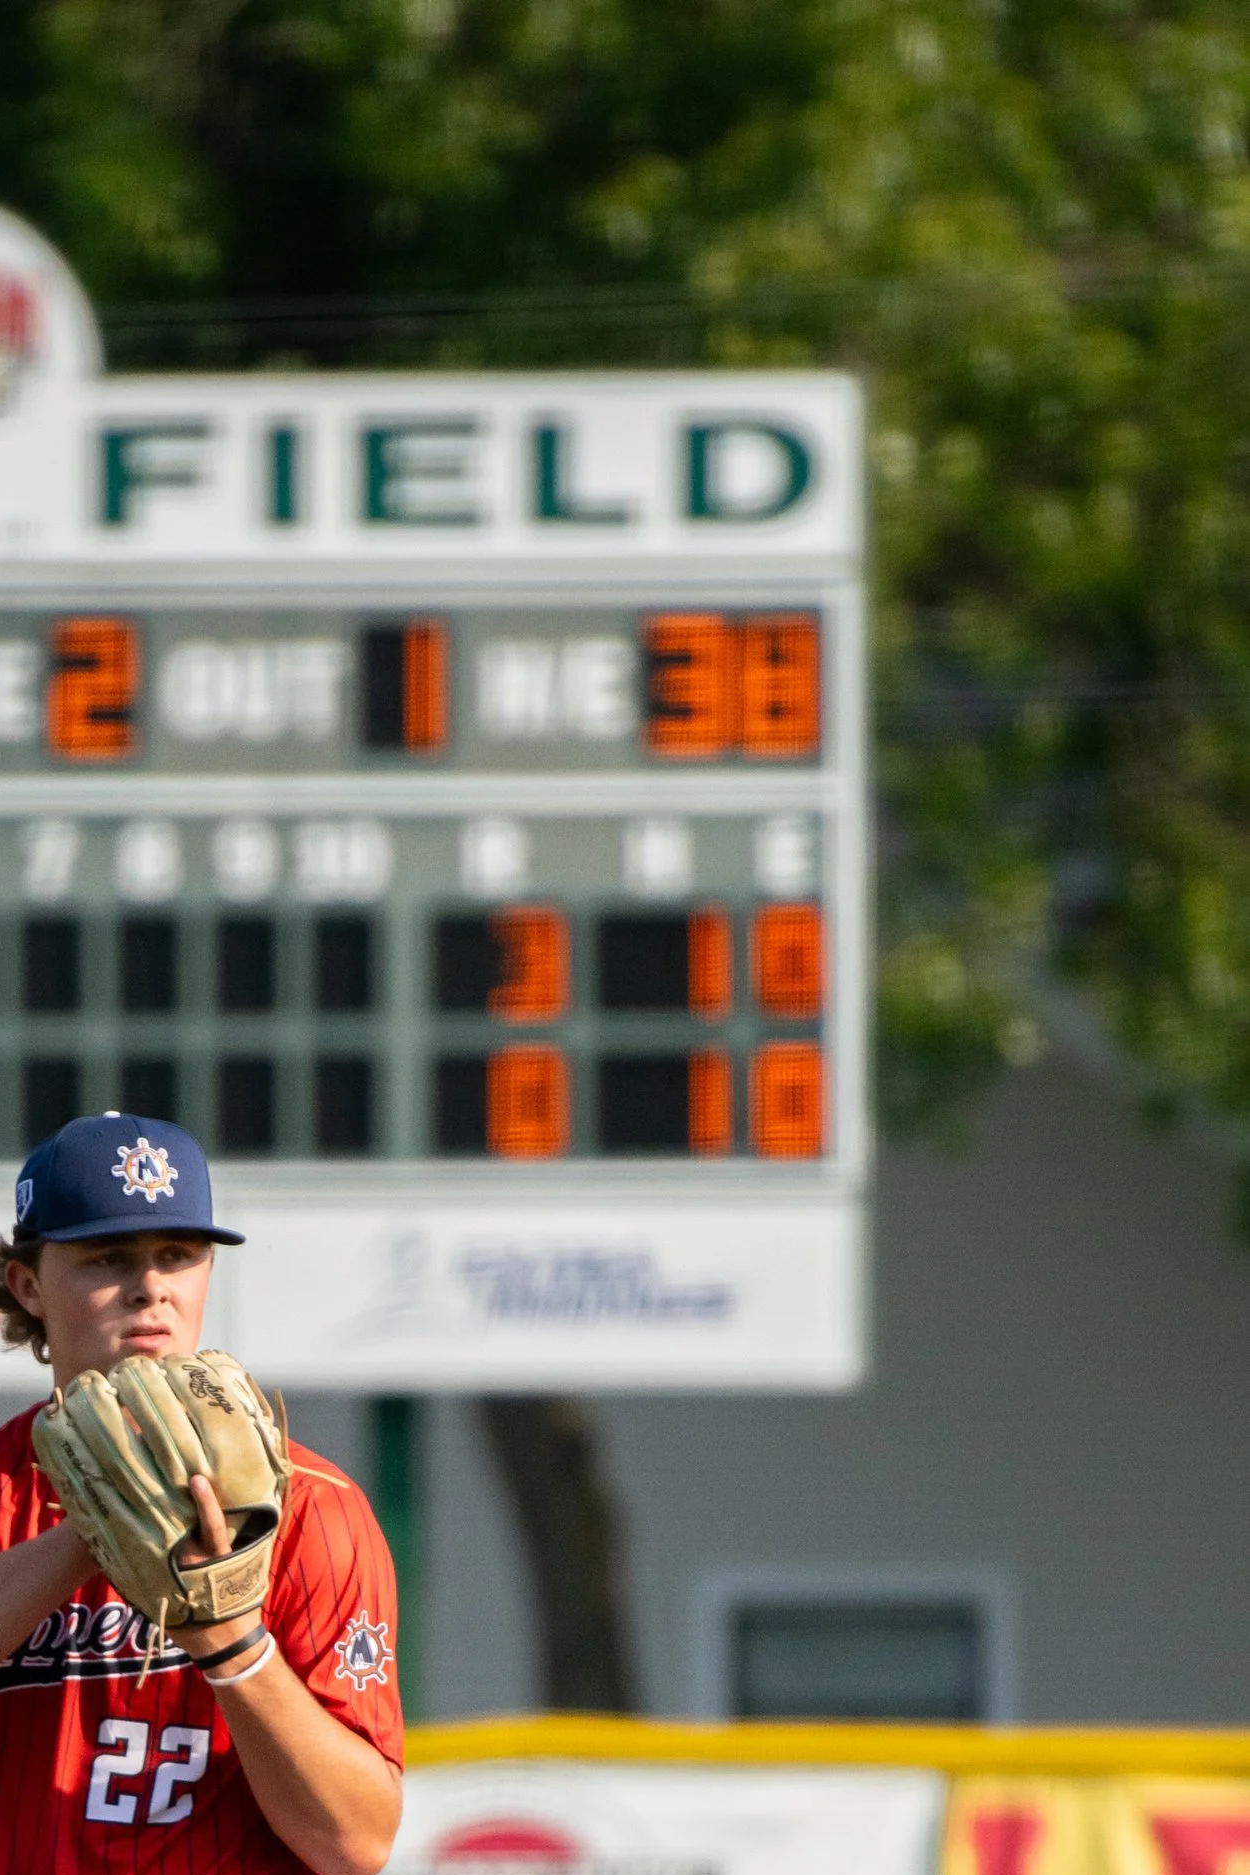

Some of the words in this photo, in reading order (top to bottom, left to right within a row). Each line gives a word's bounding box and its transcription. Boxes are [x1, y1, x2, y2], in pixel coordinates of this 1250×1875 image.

[91, 411, 816, 526] FIELD
[46, 615, 138, 764] 2
[161, 637, 342, 744] OUT
[24, 820, 81, 899] 7
[85, 1718, 210, 1825] 22
